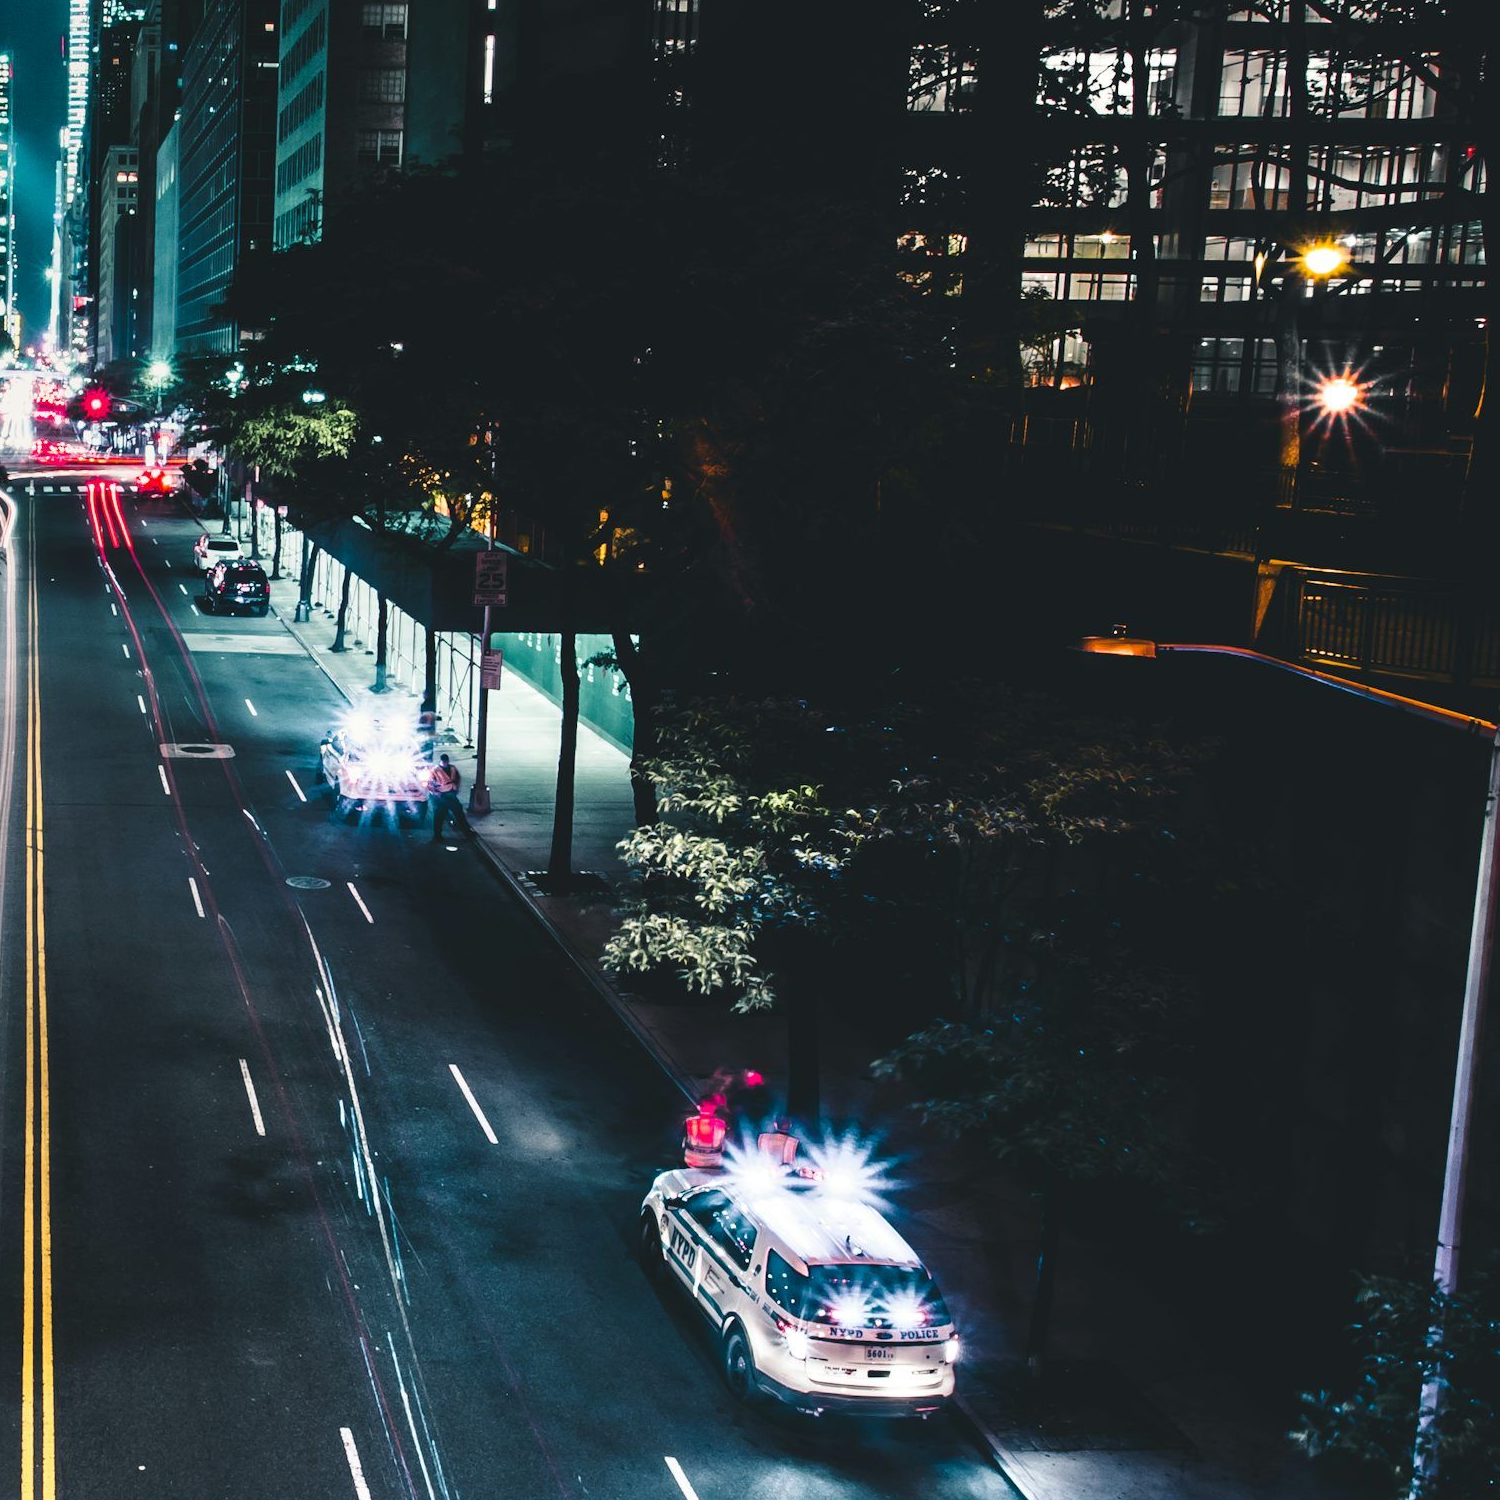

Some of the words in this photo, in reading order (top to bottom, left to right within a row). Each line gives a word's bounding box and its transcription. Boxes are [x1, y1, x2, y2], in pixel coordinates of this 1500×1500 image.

[478, 573, 504, 589] 25
[671, 1226, 696, 1269] NYPD
[830, 1327, 863, 1339] NYPD
[900, 1329, 939, 1341] POLICE
